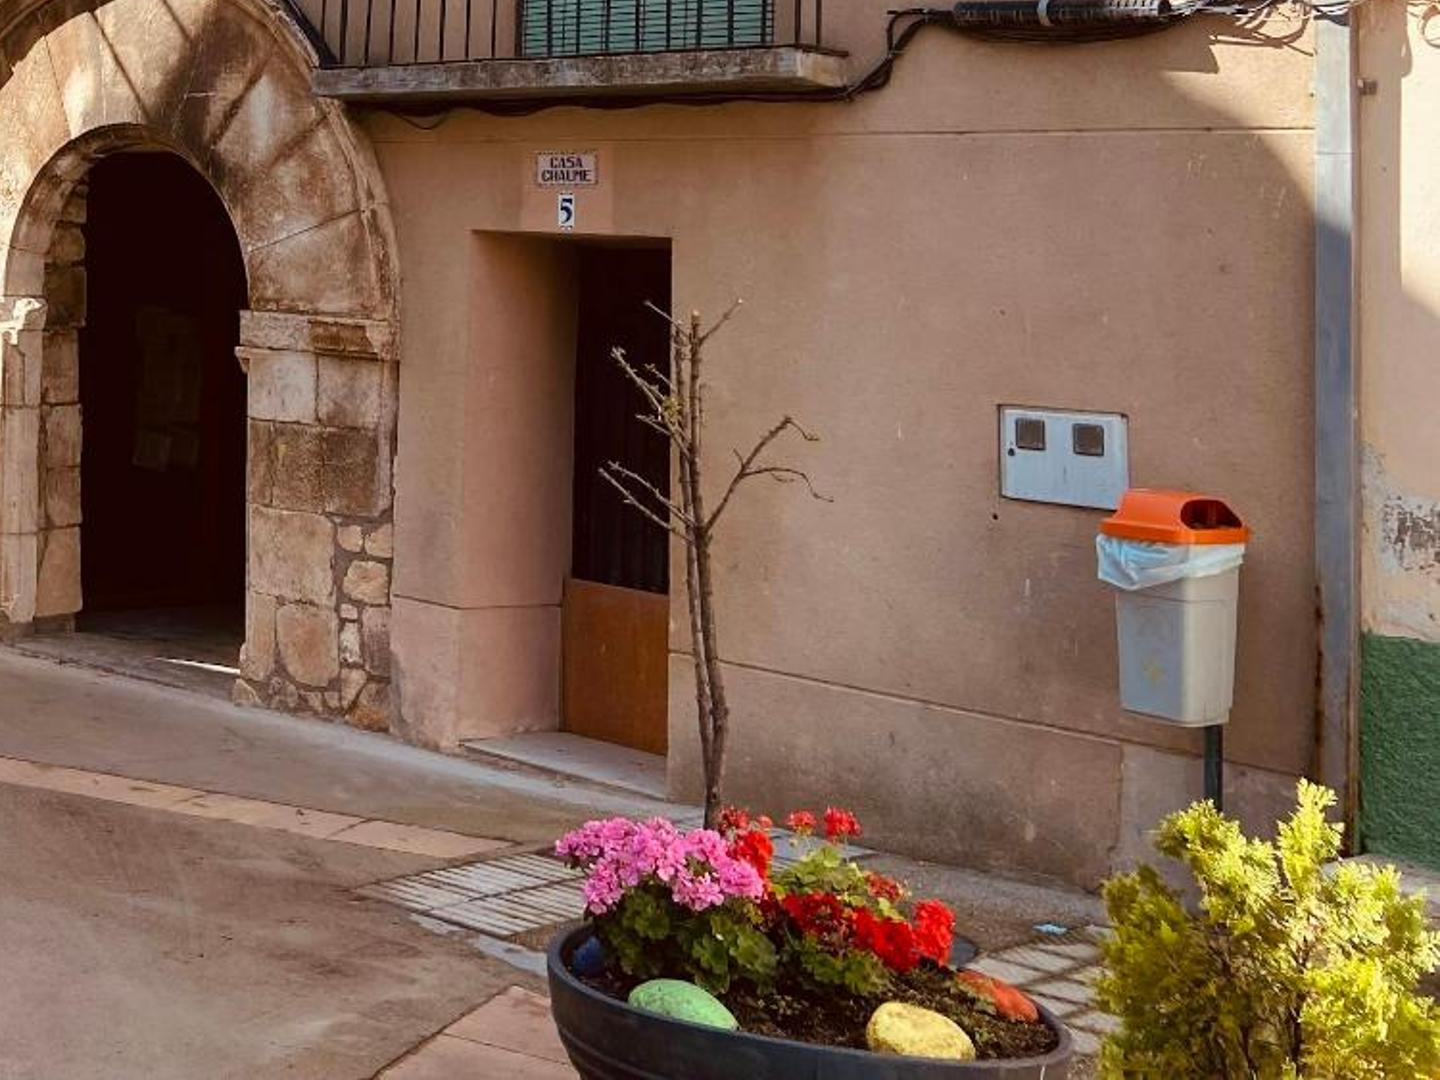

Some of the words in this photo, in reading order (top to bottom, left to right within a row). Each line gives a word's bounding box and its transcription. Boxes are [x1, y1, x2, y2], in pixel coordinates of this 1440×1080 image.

[550, 156, 583, 169] CASA
[541, 169, 592, 182] CHALME
[560, 198, 573, 224] 5
